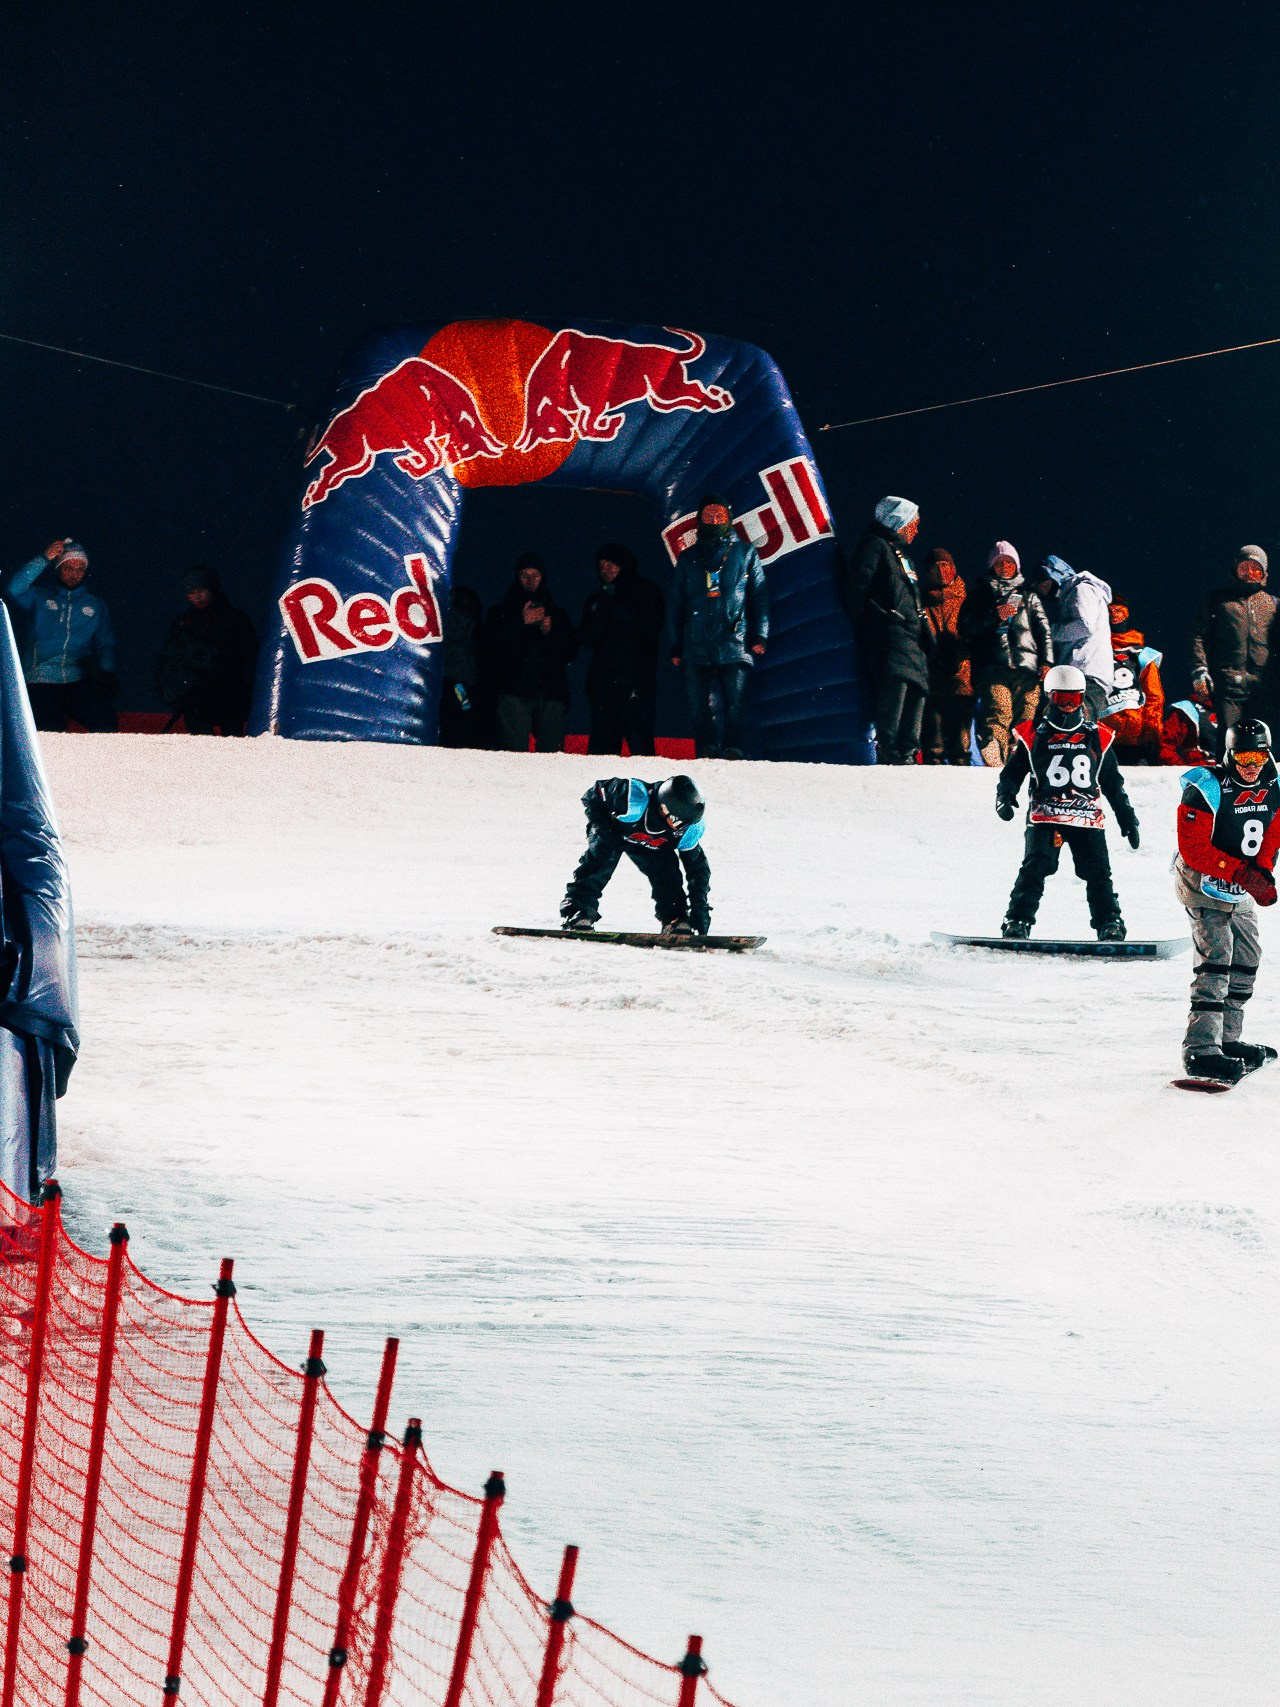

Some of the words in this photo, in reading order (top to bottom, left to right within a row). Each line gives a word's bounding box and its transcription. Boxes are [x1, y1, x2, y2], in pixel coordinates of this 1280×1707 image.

[661, 456, 833, 567] ull
[279, 553, 443, 663] Red
[1046, 754, 1092, 788] 68
[1241, 819, 1263, 856] 8
